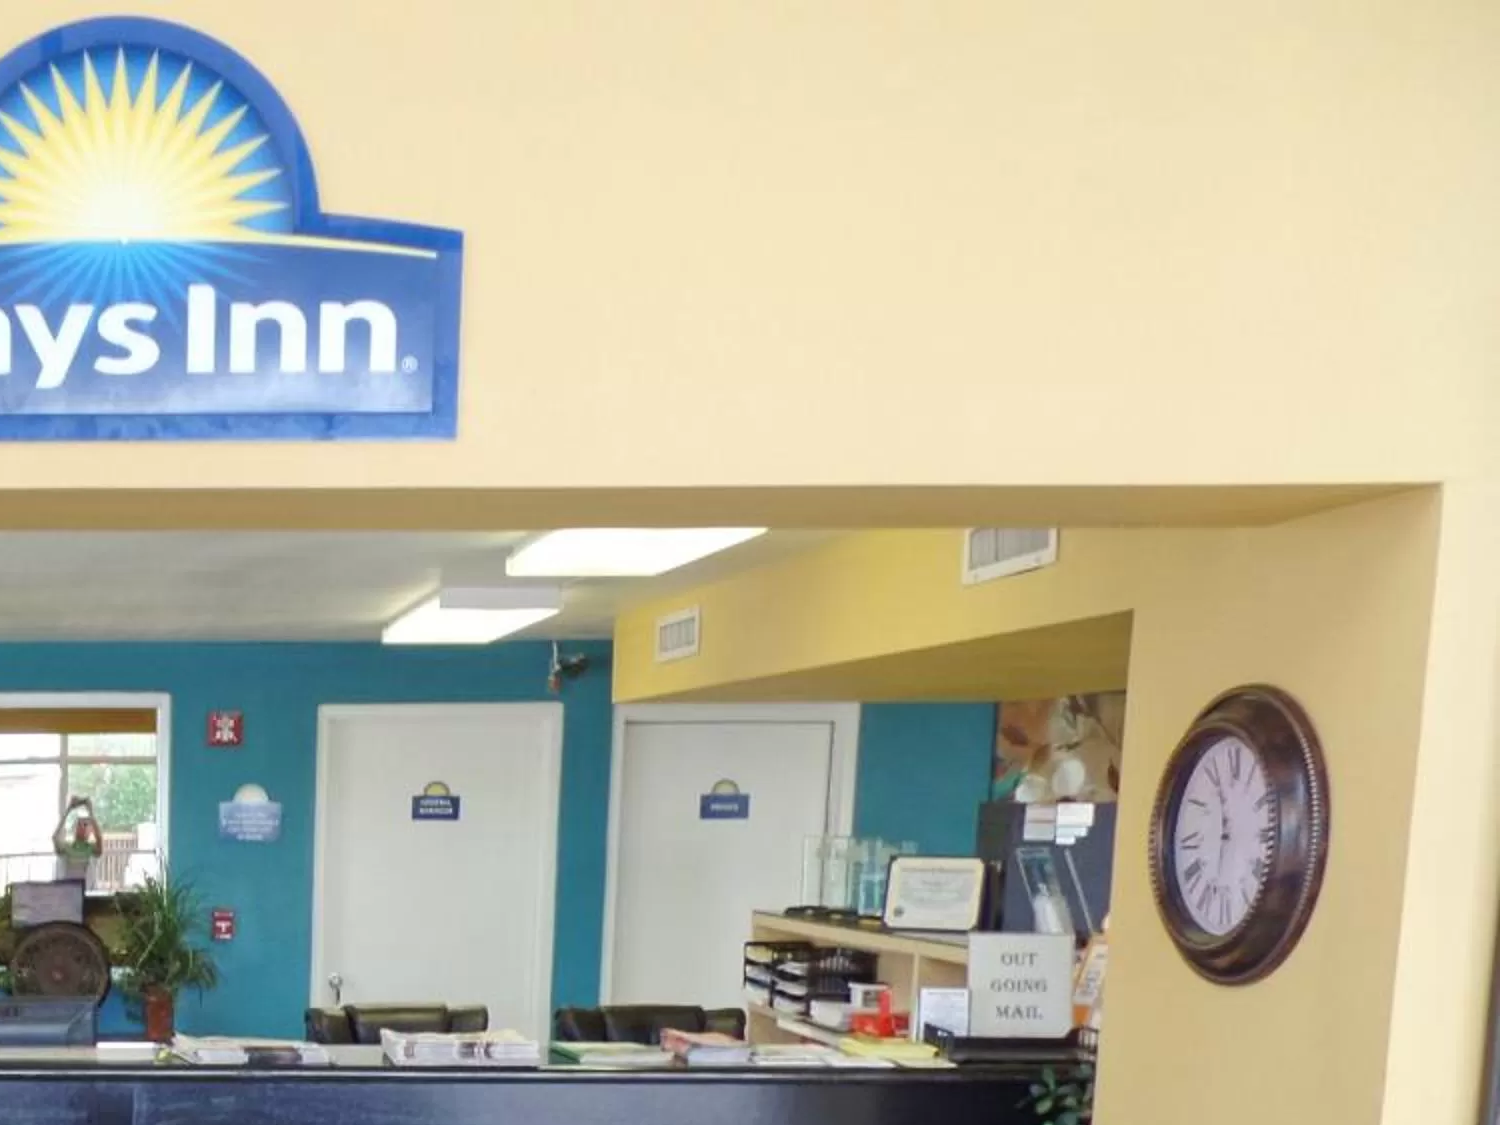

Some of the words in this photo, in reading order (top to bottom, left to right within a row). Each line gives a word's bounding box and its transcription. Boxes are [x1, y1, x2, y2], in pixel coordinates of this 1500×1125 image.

[187, 284, 397, 374] Inn
[1001, 952, 1039, 967] OUT
[990, 977, 1048, 993] GOING
[996, 1005, 1044, 1020] MAIL
